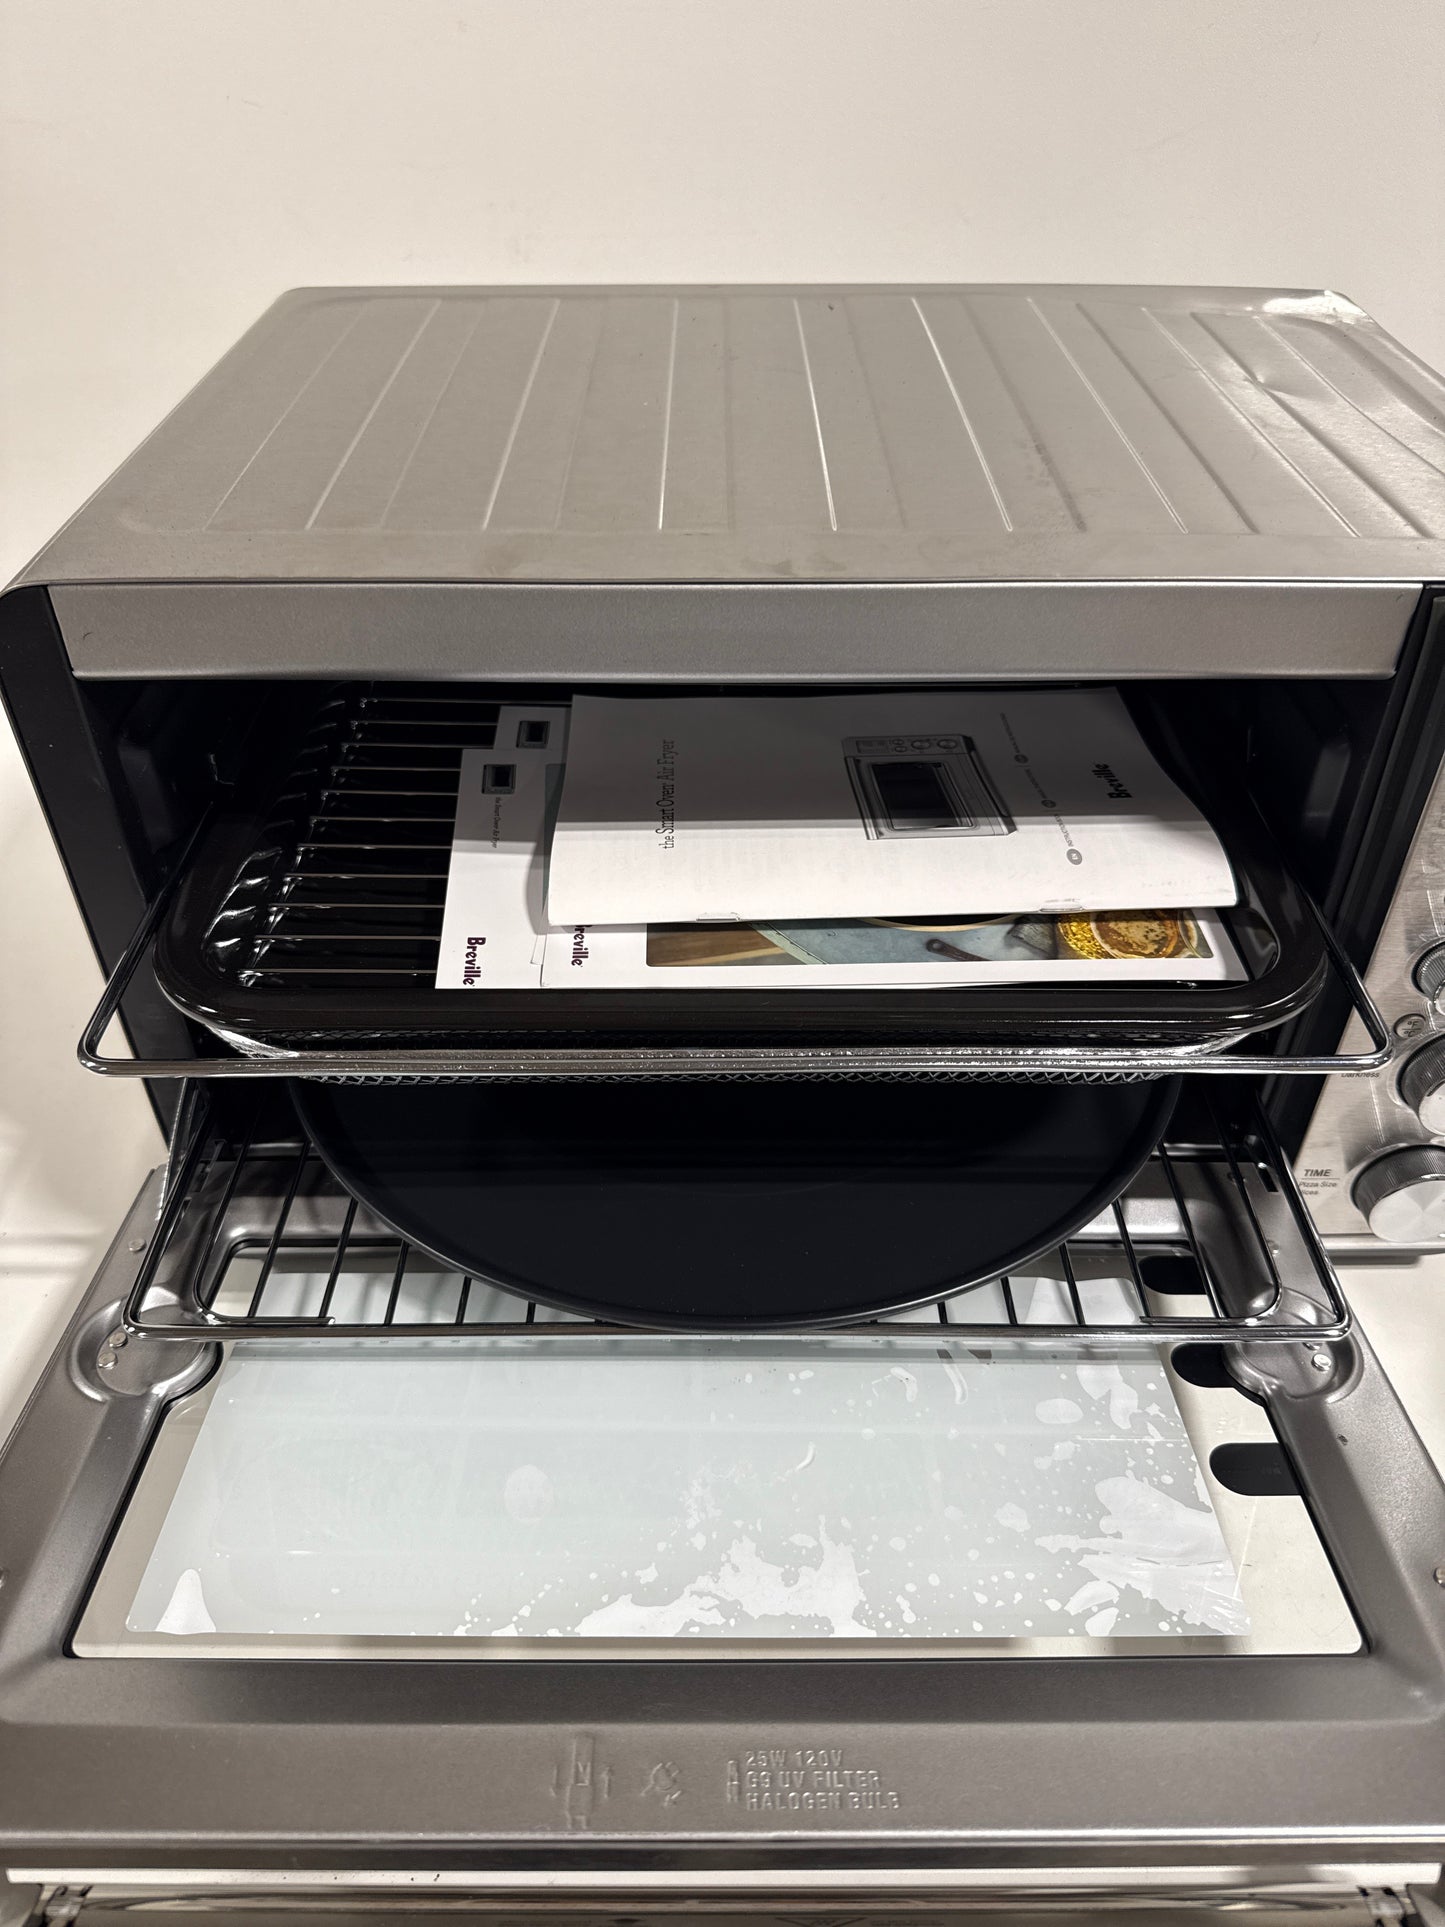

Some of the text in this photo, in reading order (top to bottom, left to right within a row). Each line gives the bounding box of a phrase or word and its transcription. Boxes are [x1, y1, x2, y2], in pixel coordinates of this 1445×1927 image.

[1091, 763, 1133, 799] Breville
[655, 740, 679, 849] the Smart Oven Air Fryer
[462, 936, 487, 987] Breville
[1304, 1168, 1332, 1177] TIME
[746, 1750, 843, 1767] 25W 120V
[779, 1770, 805, 1788] UV
[813, 1770, 880, 1788] FILTER
[746, 1791, 900, 1810] HALOGEN BULB
